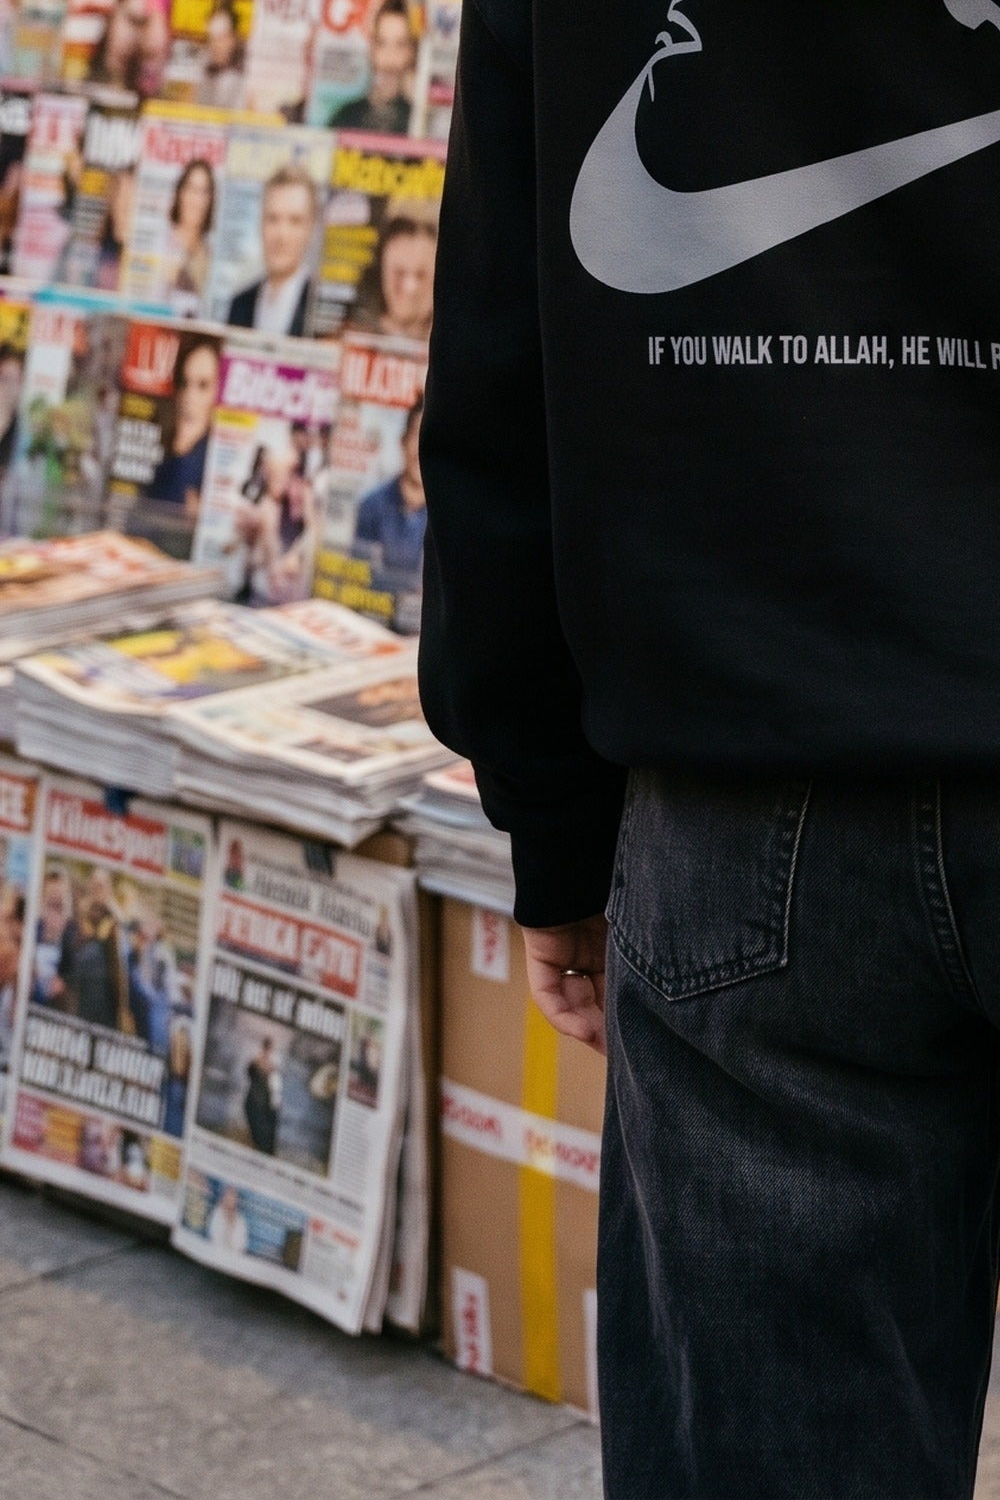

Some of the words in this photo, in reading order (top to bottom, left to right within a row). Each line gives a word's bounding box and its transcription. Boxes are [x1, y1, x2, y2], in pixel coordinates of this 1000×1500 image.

[648, 336, 665, 365] IF
[670, 336, 707, 365] YOU
[711, 335, 773, 365] WALK
[779, 334, 808, 365] TO
[813, 335, 895, 369] ALLAH,
[902, 335, 931, 365] HE
[936, 336, 987, 369] WILL
